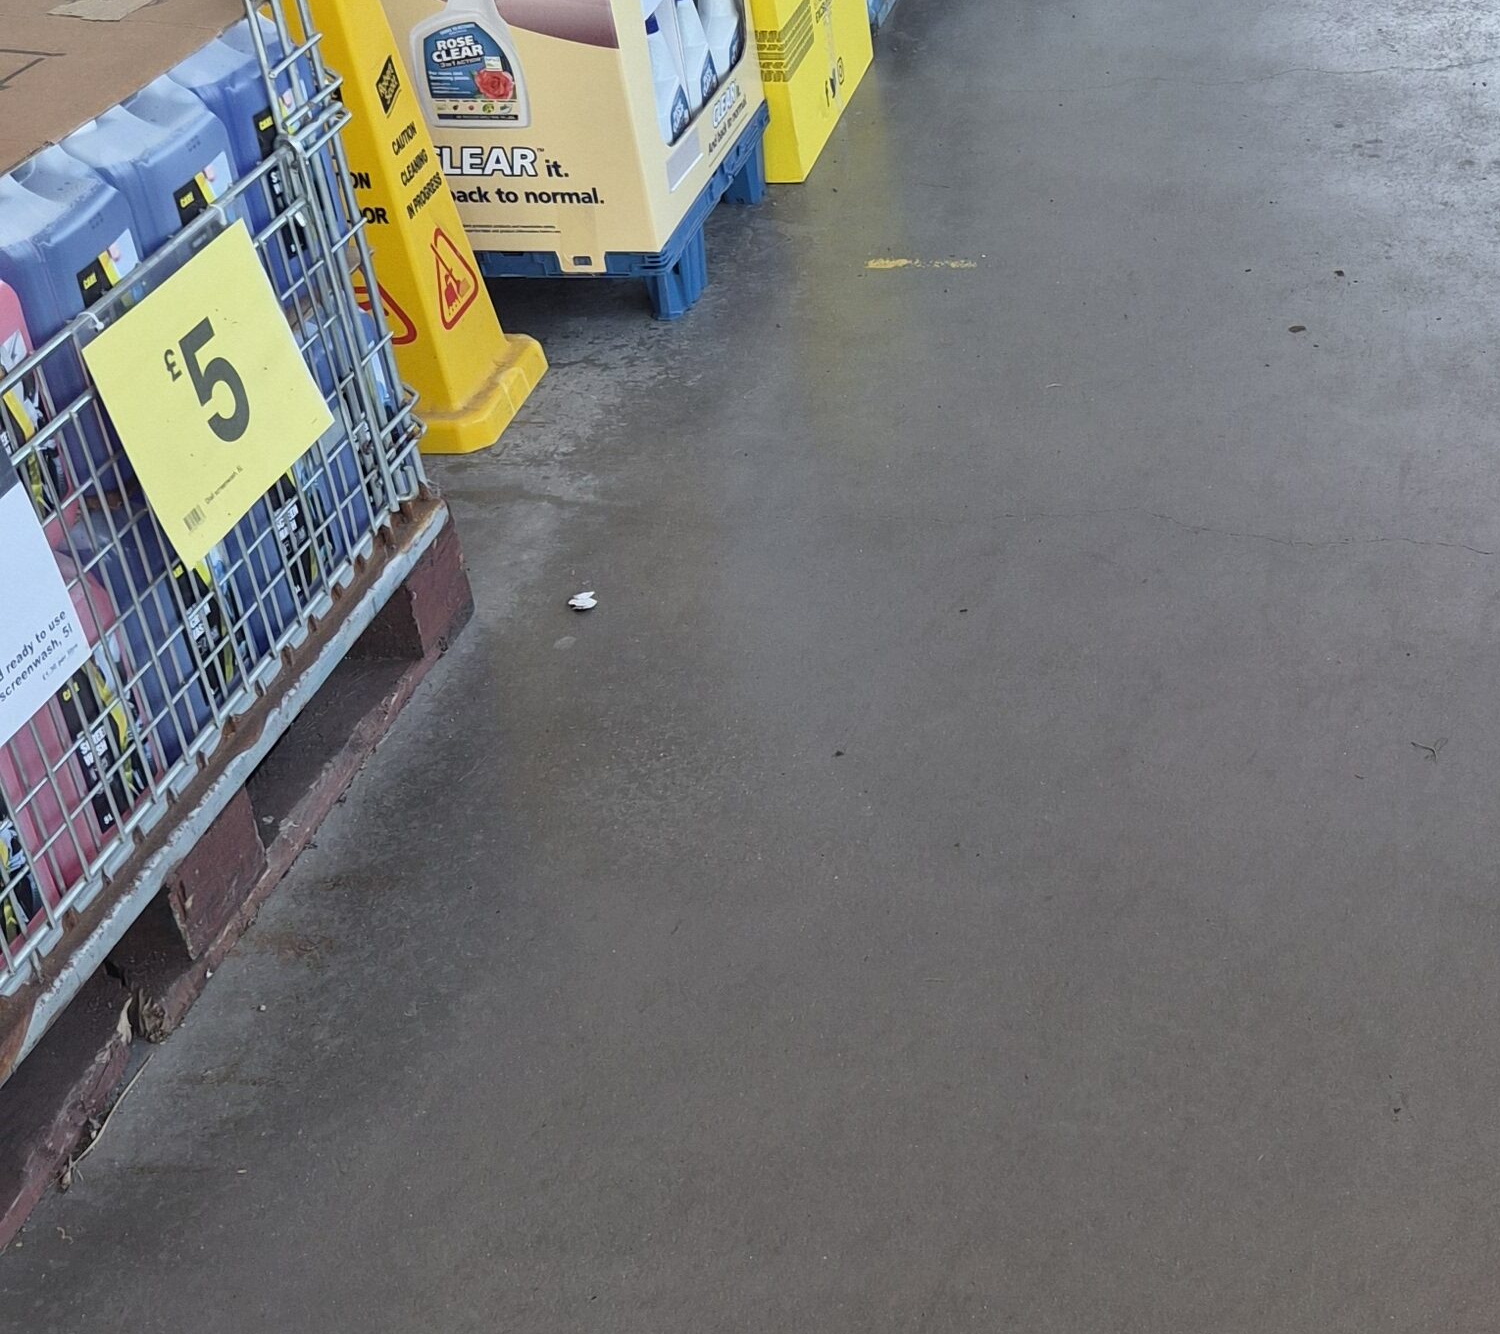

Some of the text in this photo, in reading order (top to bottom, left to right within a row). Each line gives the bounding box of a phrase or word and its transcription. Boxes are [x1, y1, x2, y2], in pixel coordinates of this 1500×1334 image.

[431, 45, 484, 63] CLEAR
[436, 35, 475, 51] ROSE
[391, 121, 418, 156] CAUTION
[400, 148, 429, 187] CLEANING
[545, 159, 570, 178] it.
[406, 171, 443, 220] IN PROGRESS
[495, 187, 519, 204] to
[524, 187, 605, 205] normal.
[164, 316, 250, 443] £5
[6, 610, 67, 677] ready to use
